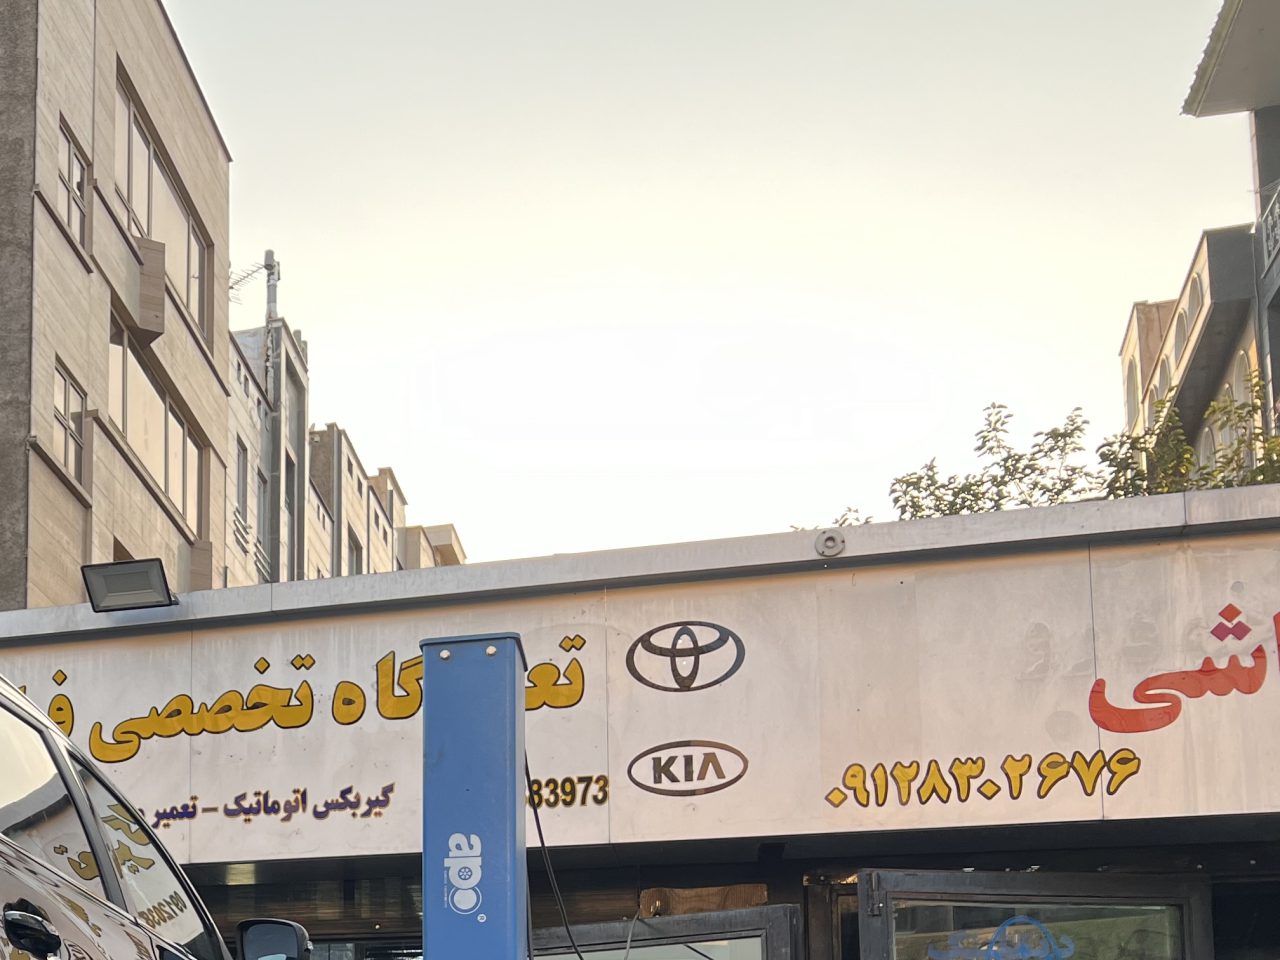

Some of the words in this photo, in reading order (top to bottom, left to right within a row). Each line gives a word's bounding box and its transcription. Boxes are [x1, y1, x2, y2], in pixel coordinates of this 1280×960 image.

[89, 654, 315, 763] تخصصی
[652, 752, 726, 785] KIA
[825, 748, 1141, 808] ۰۹۱۲۸۳۰۲۶۷۶
[151, 795, 198, 829] تعمیر
[223, 788, 308, 823] اتوماتیک
[312, 782, 395, 819] گیربکس
